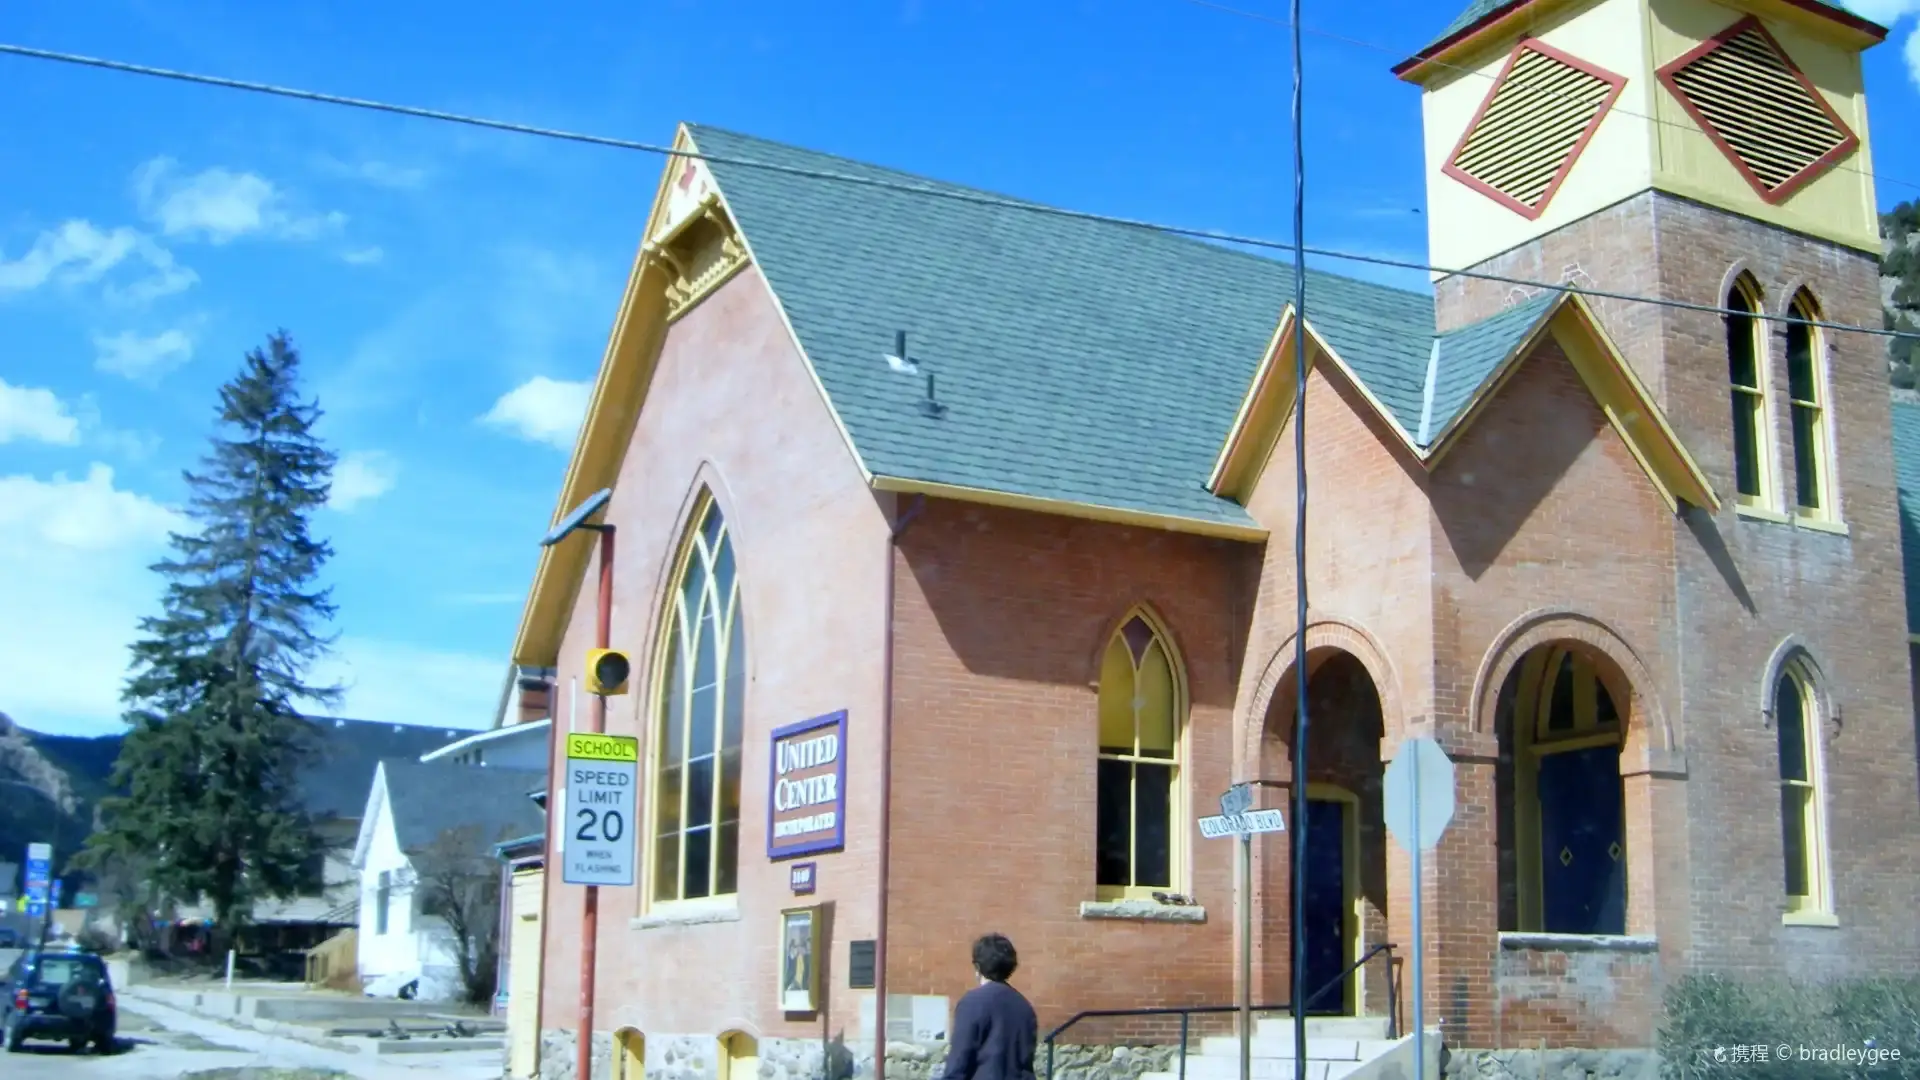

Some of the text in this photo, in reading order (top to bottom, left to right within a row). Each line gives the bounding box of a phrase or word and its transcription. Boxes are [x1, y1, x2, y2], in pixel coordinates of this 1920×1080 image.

[574, 740, 631, 756] SCHOOL
[776, 734, 838, 774] UNITED
[574, 770, 630, 786] SPEED
[578, 788, 622, 804] LIMIT
[774, 773, 837, 812] CENTER
[576, 808, 624, 842] 20
[1202, 812, 1281, 834] COLORADO BLVD
[586, 850, 612, 859] WHEN
[574, 863, 622, 874] FLASHING
